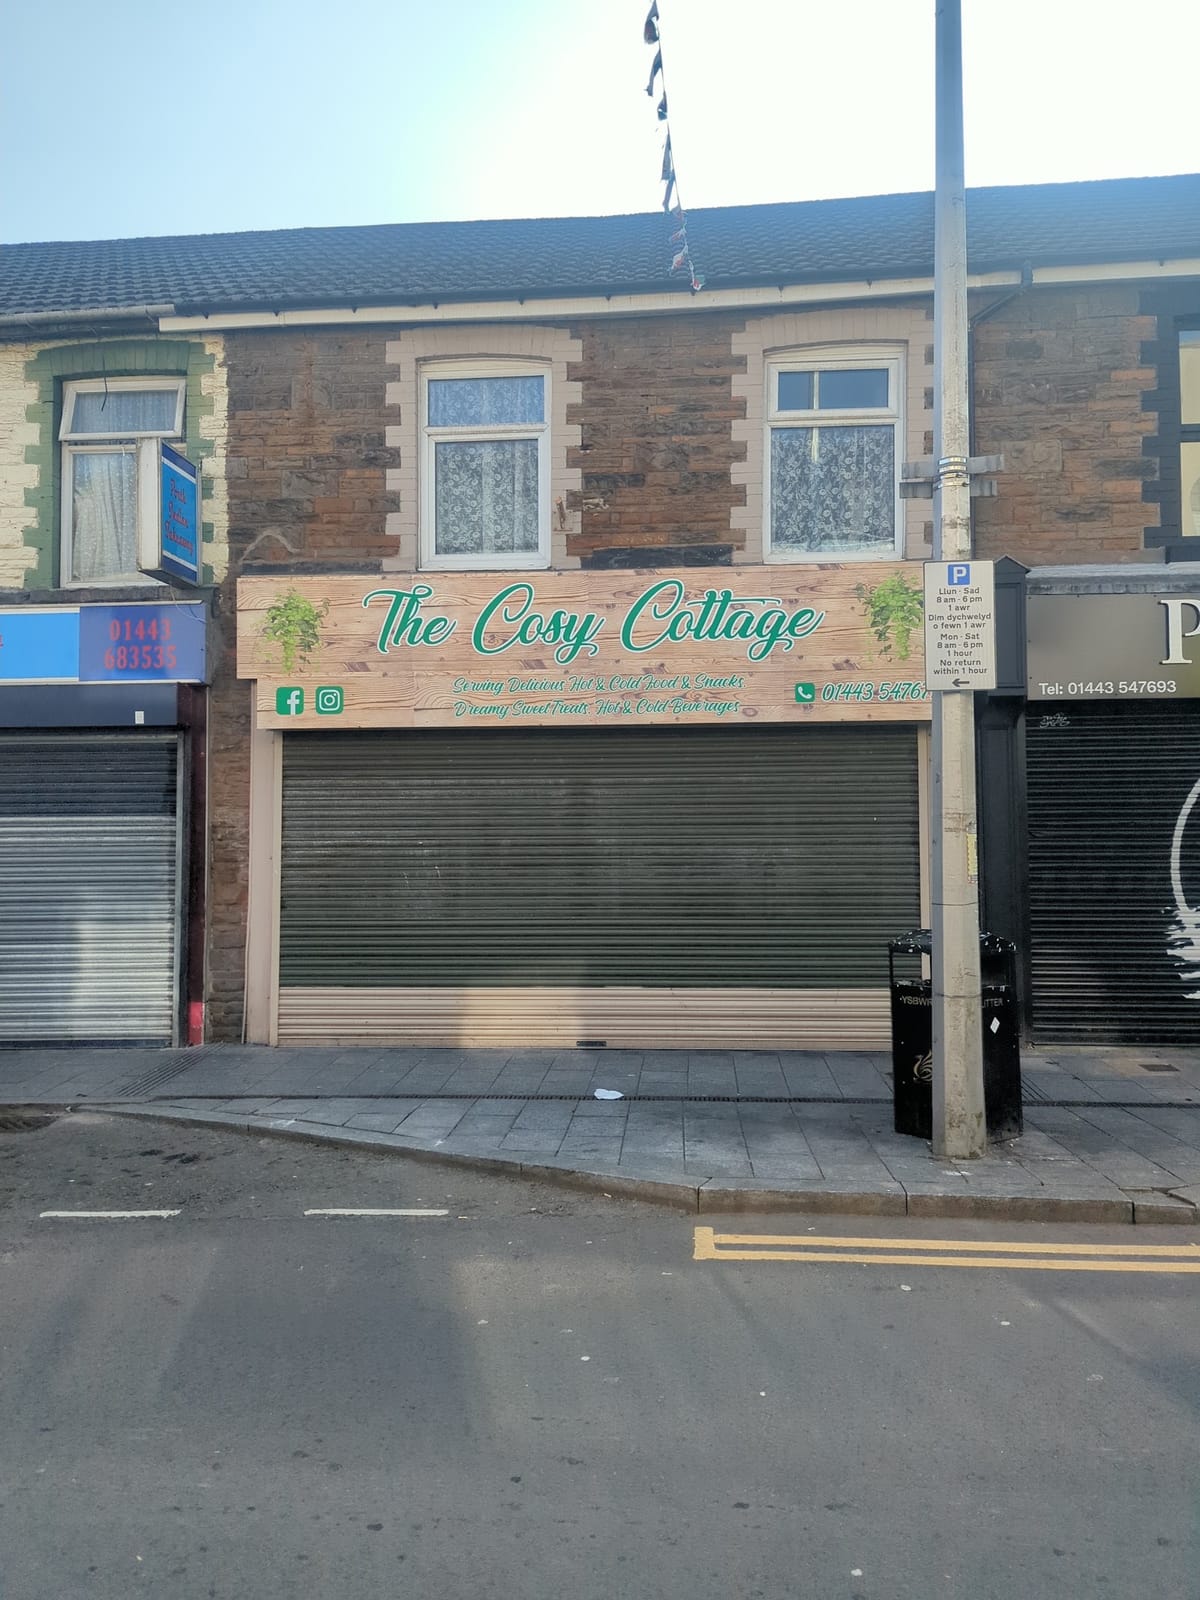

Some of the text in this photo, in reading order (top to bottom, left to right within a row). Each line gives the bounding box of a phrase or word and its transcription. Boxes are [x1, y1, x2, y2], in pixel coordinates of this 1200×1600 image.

[953, 566, 967, 584] P
[962, 595, 968, 603] 6
[362, 578, 825, 665] The Cosy Cottage
[946, 612, 992, 622] dychwelyd
[110, 617, 171, 641] 01443
[940, 621, 962, 629] fewn
[940, 633, 959, 641] Mon
[965, 632, 980, 640] Sat
[104, 645, 177, 670] 683535
[940, 659, 952, 667] No
[933, 667, 960, 675] within
[453, 676, 504, 696] Serving
[508, 676, 565, 693] Delicious
[568, 674, 594, 692] Hot
[595, 676, 606, 691] &
[609, 674, 642, 691] Cold
[643, 673, 680, 690] Food
[681, 675, 692, 690] &
[822, 682, 874, 702] 01443
[1038, 680, 1177, 695] Tel: 01443 547693
[453, 700, 509, 720] Dreamy
[511, 699, 551, 717] Sweet
[595, 698, 620, 716] Hot
[622, 699, 633, 714] &
[636, 697, 669, 715] Cold
[671, 696, 741, 717] Beverages
[981, 997, 1004, 1009] ITTER
